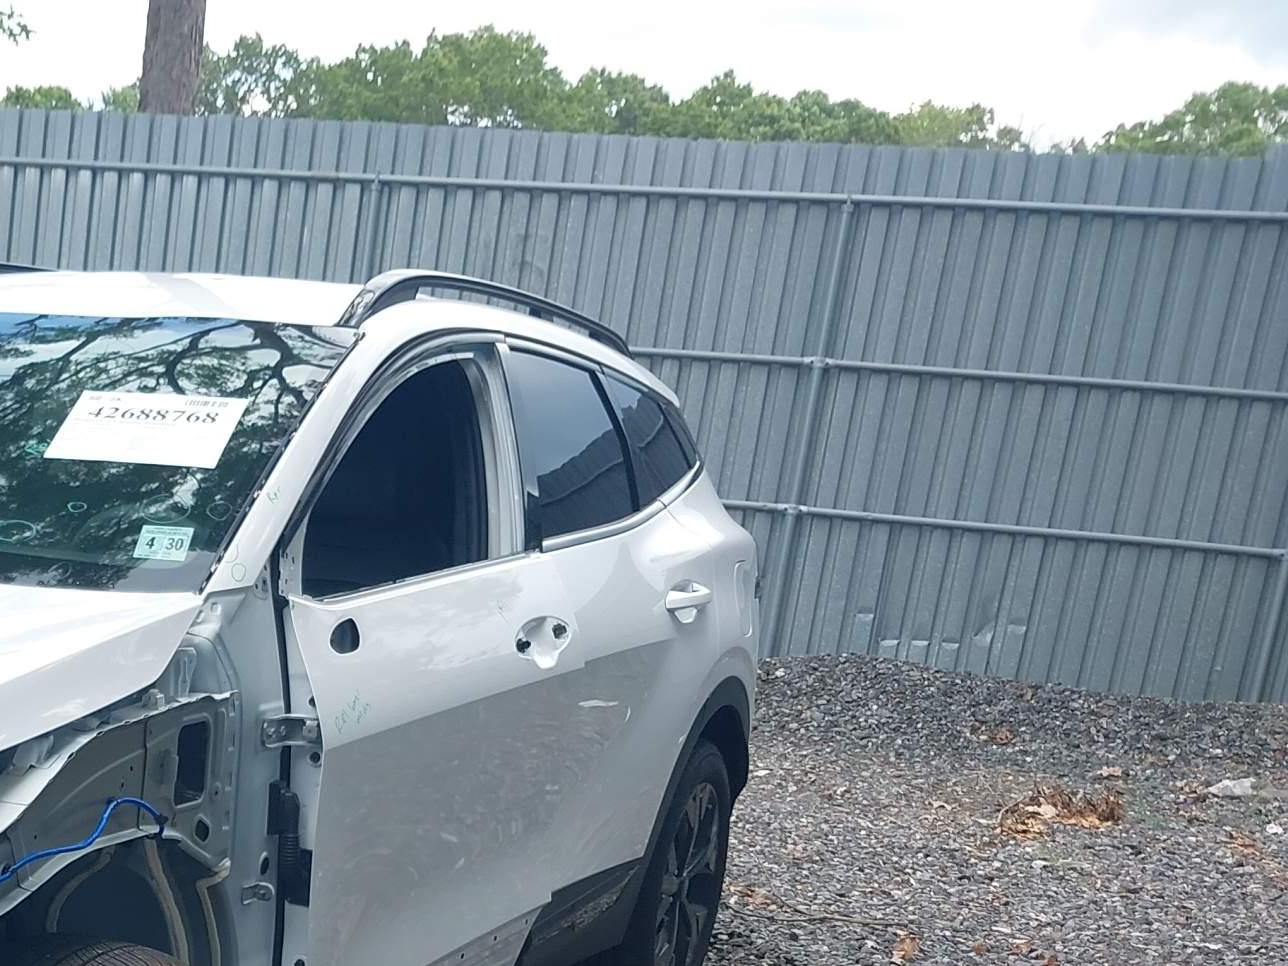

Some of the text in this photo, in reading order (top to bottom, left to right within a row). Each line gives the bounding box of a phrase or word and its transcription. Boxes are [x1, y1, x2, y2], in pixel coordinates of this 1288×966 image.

[89, 406, 219, 424] 42688768
[145, 536, 184, 551] 4 30
